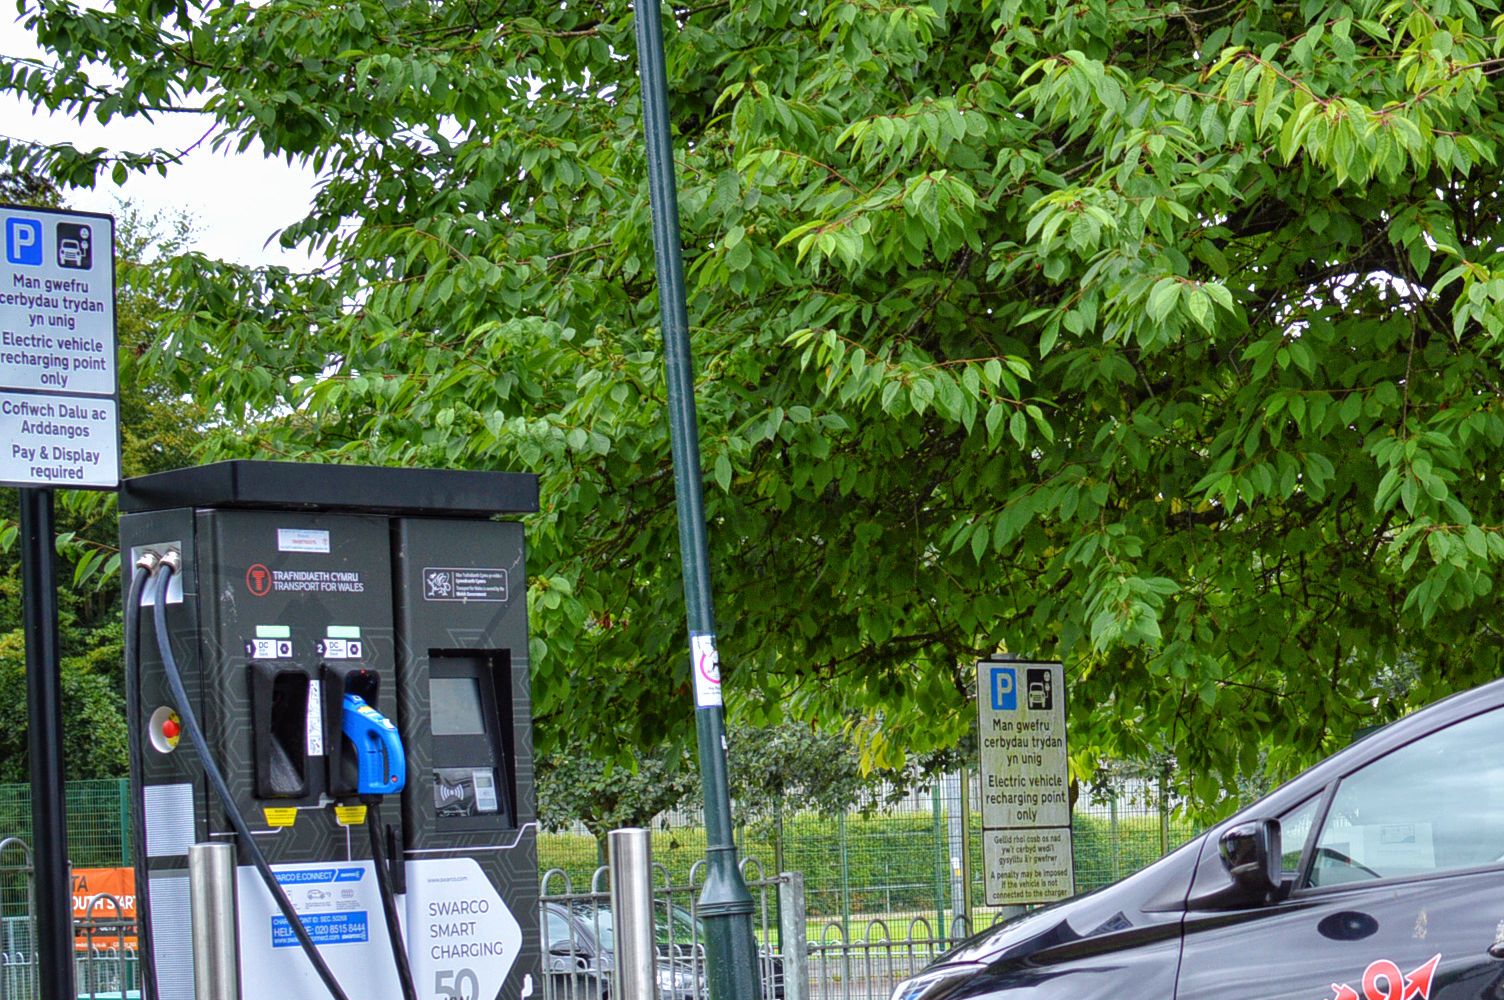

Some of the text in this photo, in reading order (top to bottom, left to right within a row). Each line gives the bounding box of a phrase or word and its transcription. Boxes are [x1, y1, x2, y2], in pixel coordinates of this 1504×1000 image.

[13, 223, 35, 259] P
[13, 273, 89, 293] Man gwefru
[0, 292, 104, 313] cerbydau trydan
[29, 314, 75, 330] yn unig
[2, 331, 103, 353] Electric vehicle
[0, 351, 106, 371] recharging point
[40, 371, 68, 388] only
[2, 400, 107, 420] Cofiwch Dalu ac
[21, 420, 90, 439] Arddangos
[12, 444, 100, 465] Pay & Display
[30, 465, 84, 480] required
[273, 571, 358, 582] TRAFNIDIAETH CYMRU
[273, 581, 364, 592] TRANSPORT FOR WALES
[996, 673, 1013, 706] P
[993, 719, 1049, 734] Man gwefru
[984, 736, 1062, 749] cerbydau trydan
[1007, 752, 1042, 766] yn unig
[988, 773, 1062, 787] Electric vehicle
[986, 791, 1066, 806] recharging point
[1016, 808, 1037, 821] only
[429, 900, 489, 916] SWARCO
[430, 922, 476, 938] SMART
[431, 942, 503, 959] CHARGING
